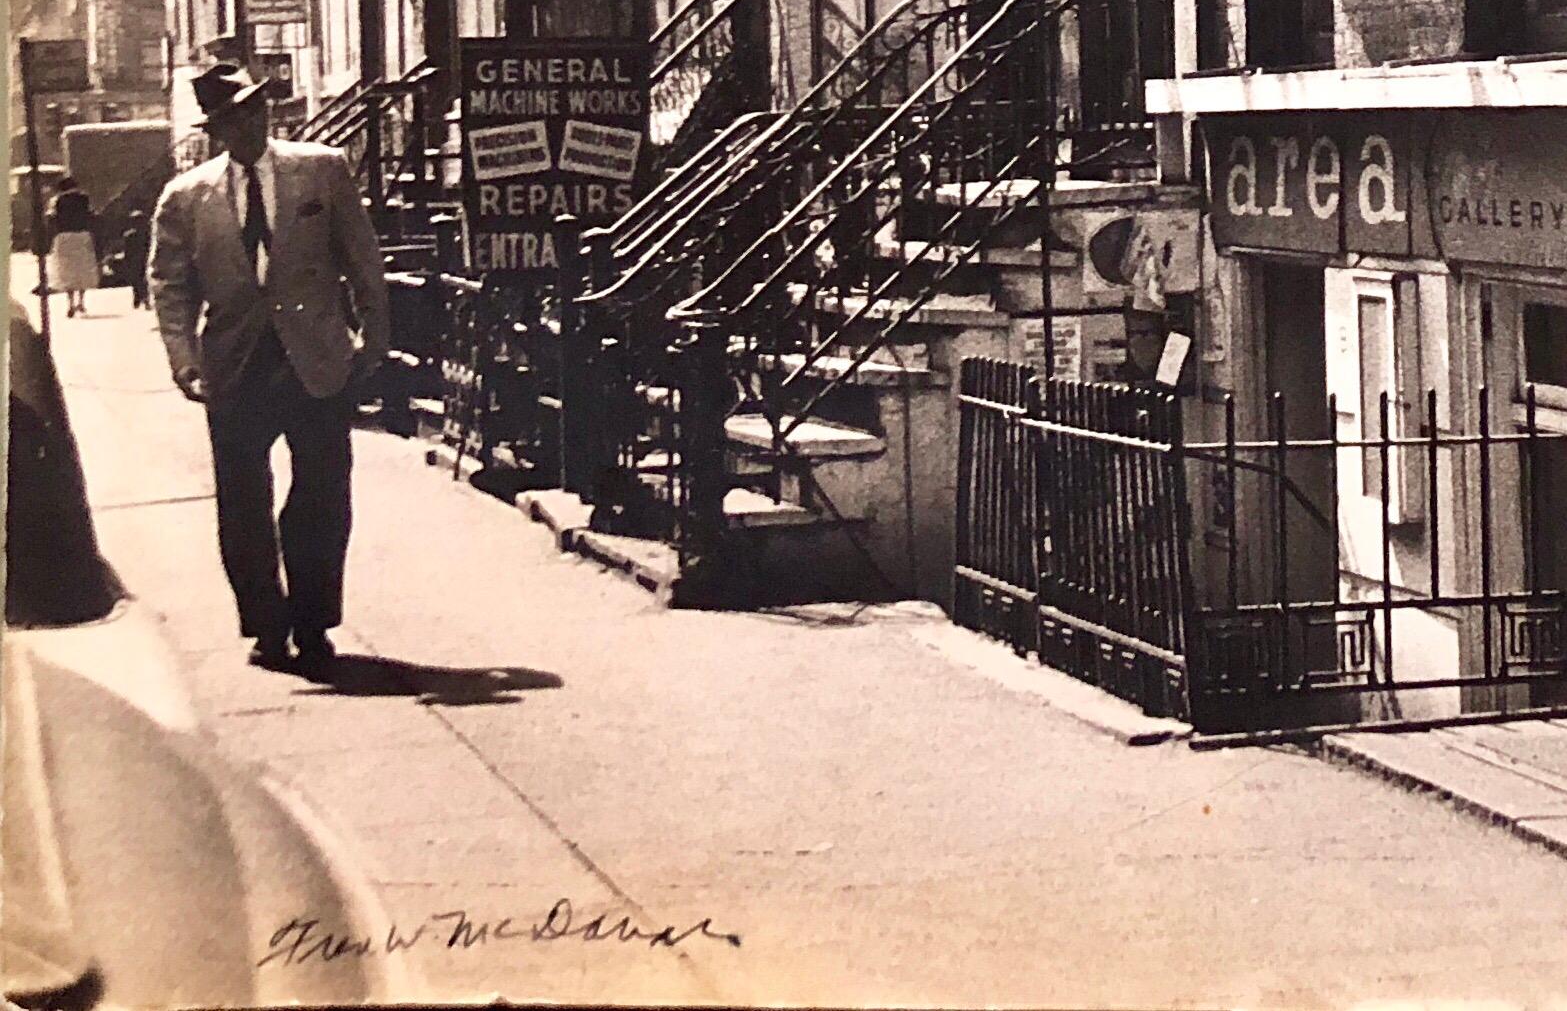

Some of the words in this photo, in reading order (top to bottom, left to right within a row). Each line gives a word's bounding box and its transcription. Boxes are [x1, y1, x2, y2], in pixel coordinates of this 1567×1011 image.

[476, 58, 632, 84] GENERAL
[469, 90, 560, 114] MACHINE
[567, 90, 642, 115] WORKS
[1226, 134, 1406, 225] area
[480, 184, 634, 217] REPAIRS
[1438, 195, 1566, 231] GALLERY
